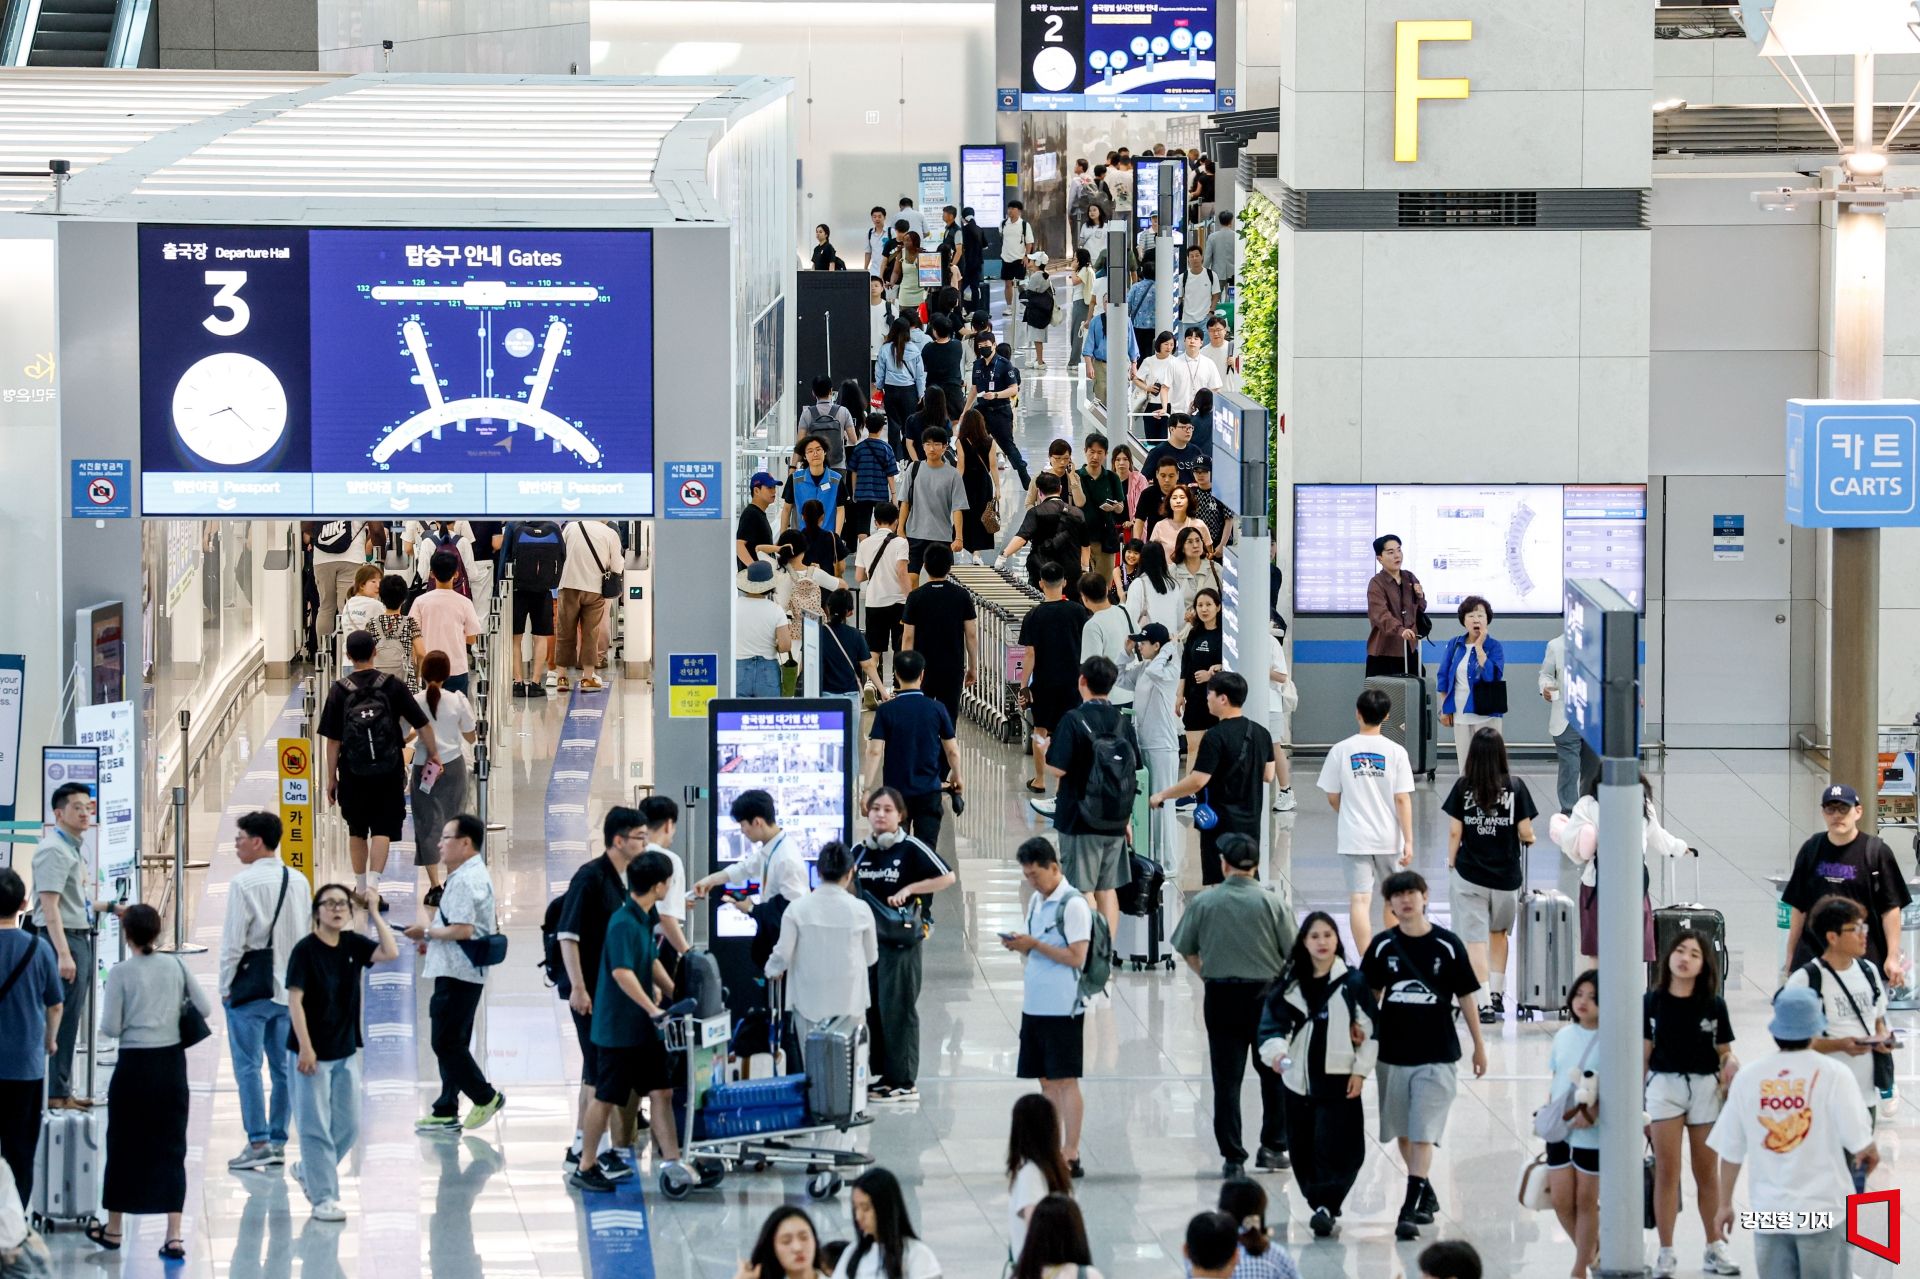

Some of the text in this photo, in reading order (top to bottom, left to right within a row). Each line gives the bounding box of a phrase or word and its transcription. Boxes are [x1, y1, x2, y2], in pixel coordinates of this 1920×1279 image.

[1044, 14, 1063, 42] 2
[1394, 20, 1472, 162] F
[162, 242, 208, 260] 출국장
[215, 247, 290, 260] Departure Hall
[405, 245, 562, 267] 탑승구 안내 Gates
[202, 270, 250, 336] 3
[1832, 434, 1903, 470] 카트
[79, 463, 123, 471] 사진촬영금지
[224, 481, 281, 495] Passport
[397, 481, 454, 495] Passport
[568, 481, 625, 495] Passport
[1830, 477, 1902, 496] CARTS
[320, 520, 346, 538] NIKE
[741, 714, 774, 724] 출국장별
[802, 714, 819, 724] 상황
[290, 781, 302, 790] No
[285, 791, 307, 800] Carts
[1760, 1079, 1805, 1096] SOLE
[1760, 1098, 1805, 1109] FOOD
